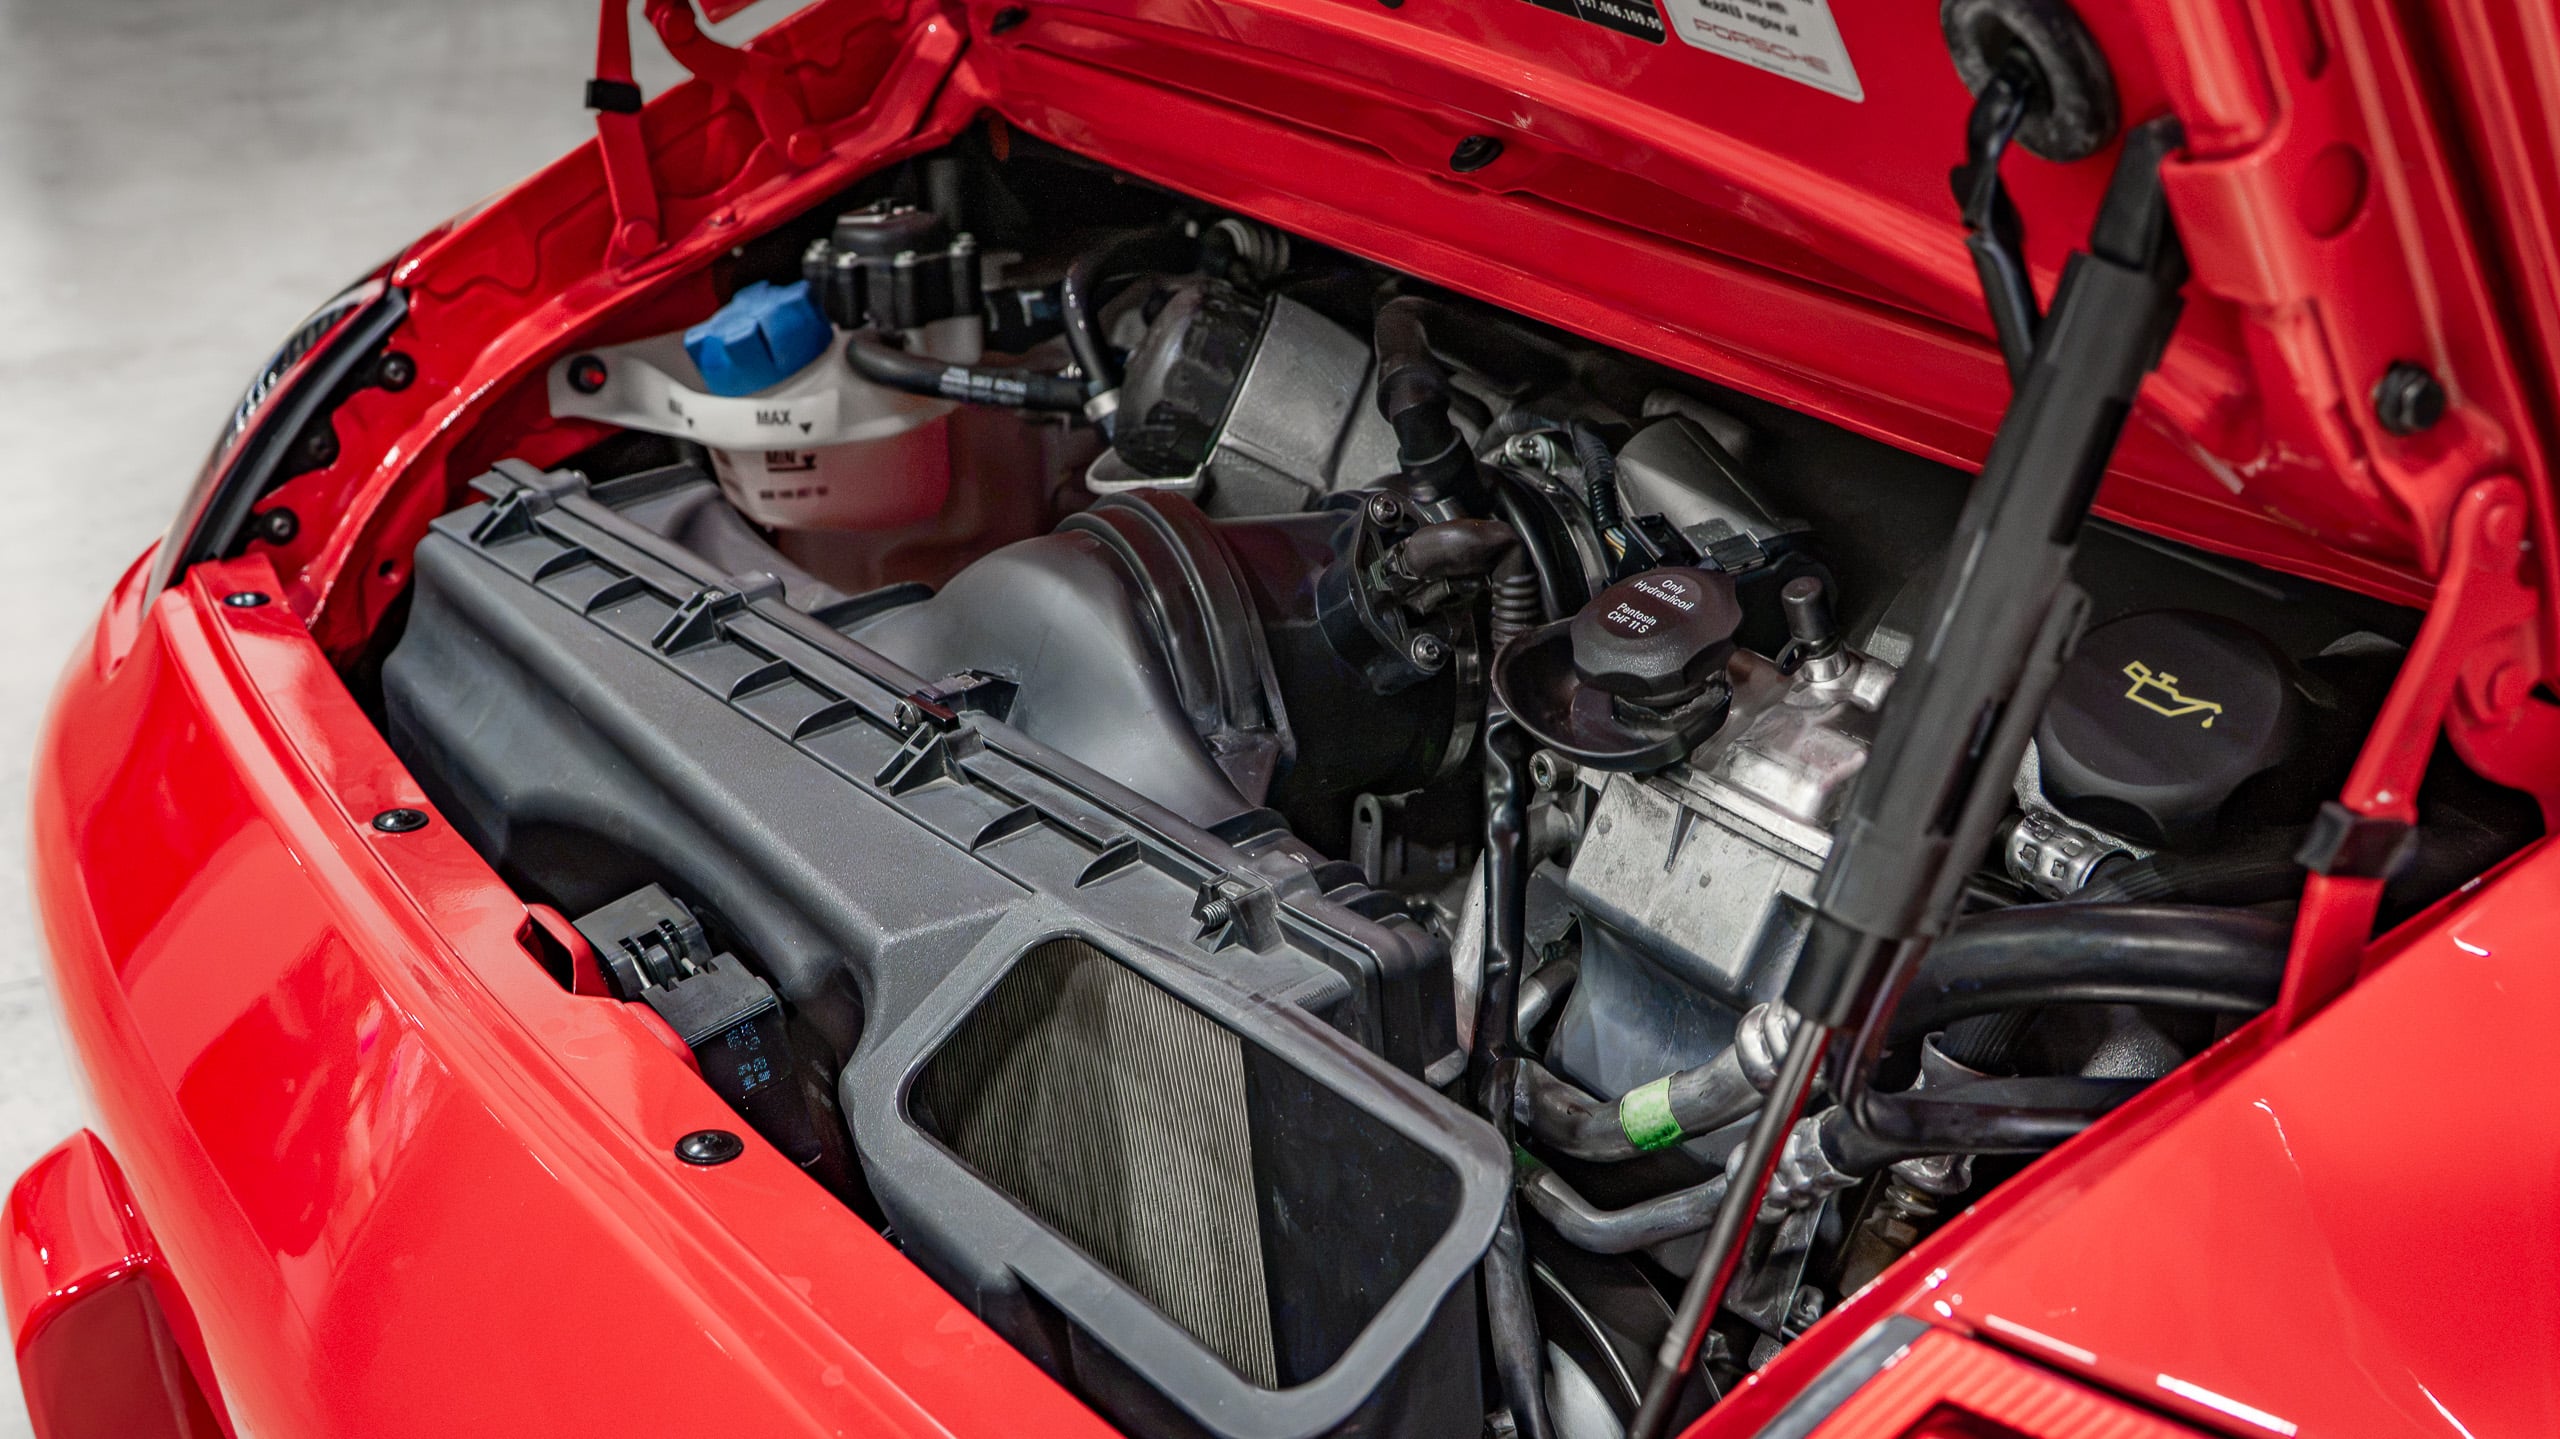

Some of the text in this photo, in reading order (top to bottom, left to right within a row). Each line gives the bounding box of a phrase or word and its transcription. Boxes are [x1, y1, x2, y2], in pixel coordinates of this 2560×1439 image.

[1693, 17, 1831, 75] PORSCHE
[756, 409, 791, 425] MAX
[765, 450, 796, 465] MIN
[1634, 580, 1695, 612] Hydraulicoil
[1661, 579, 1686, 595] Only
[1607, 610, 1649, 634] CHF 11 S
[1616, 602, 1657, 626] Pantosin
